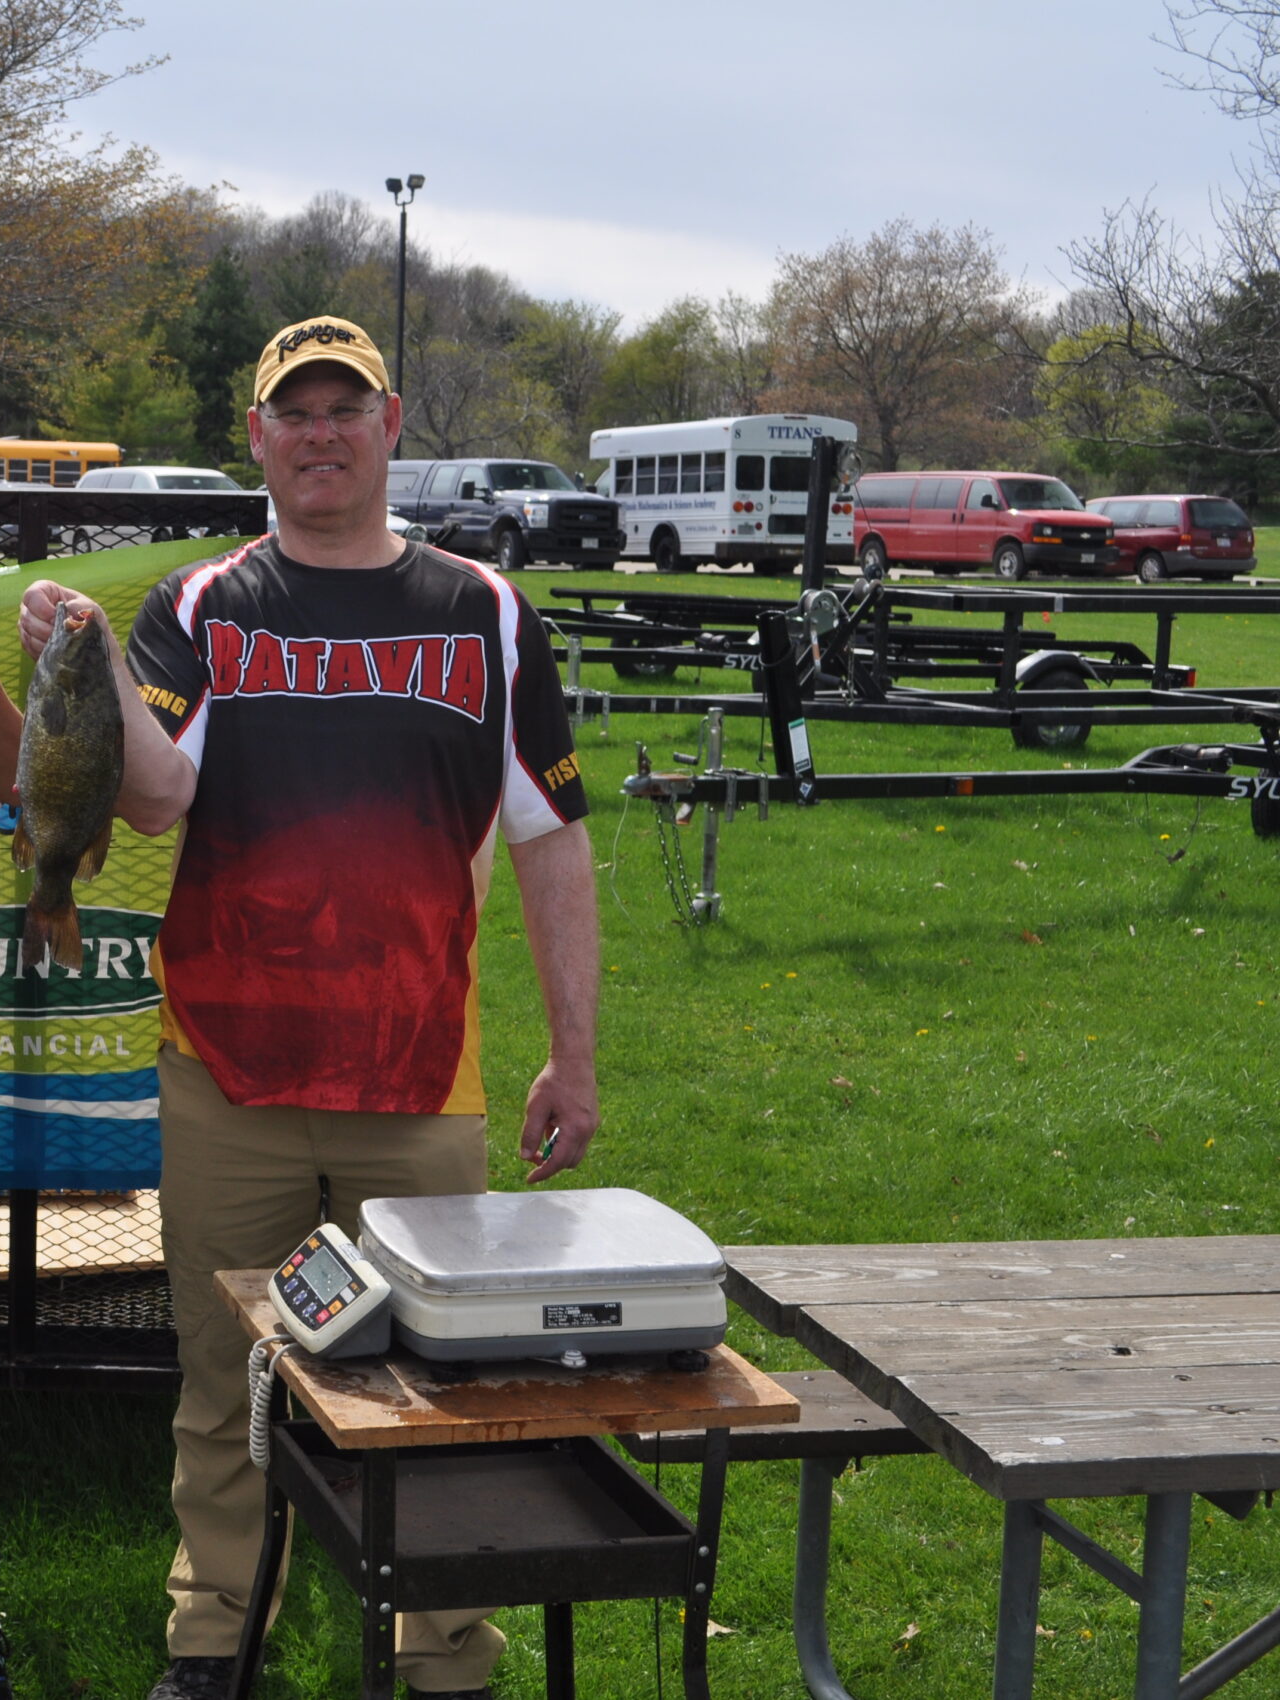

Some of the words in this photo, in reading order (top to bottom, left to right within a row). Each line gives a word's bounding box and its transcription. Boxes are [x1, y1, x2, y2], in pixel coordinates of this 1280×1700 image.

[276, 323, 356, 363] Ranger
[767, 425, 823, 440] TITANS
[204, 618, 487, 724] BATAVIA
[136, 683, 188, 717] HING
